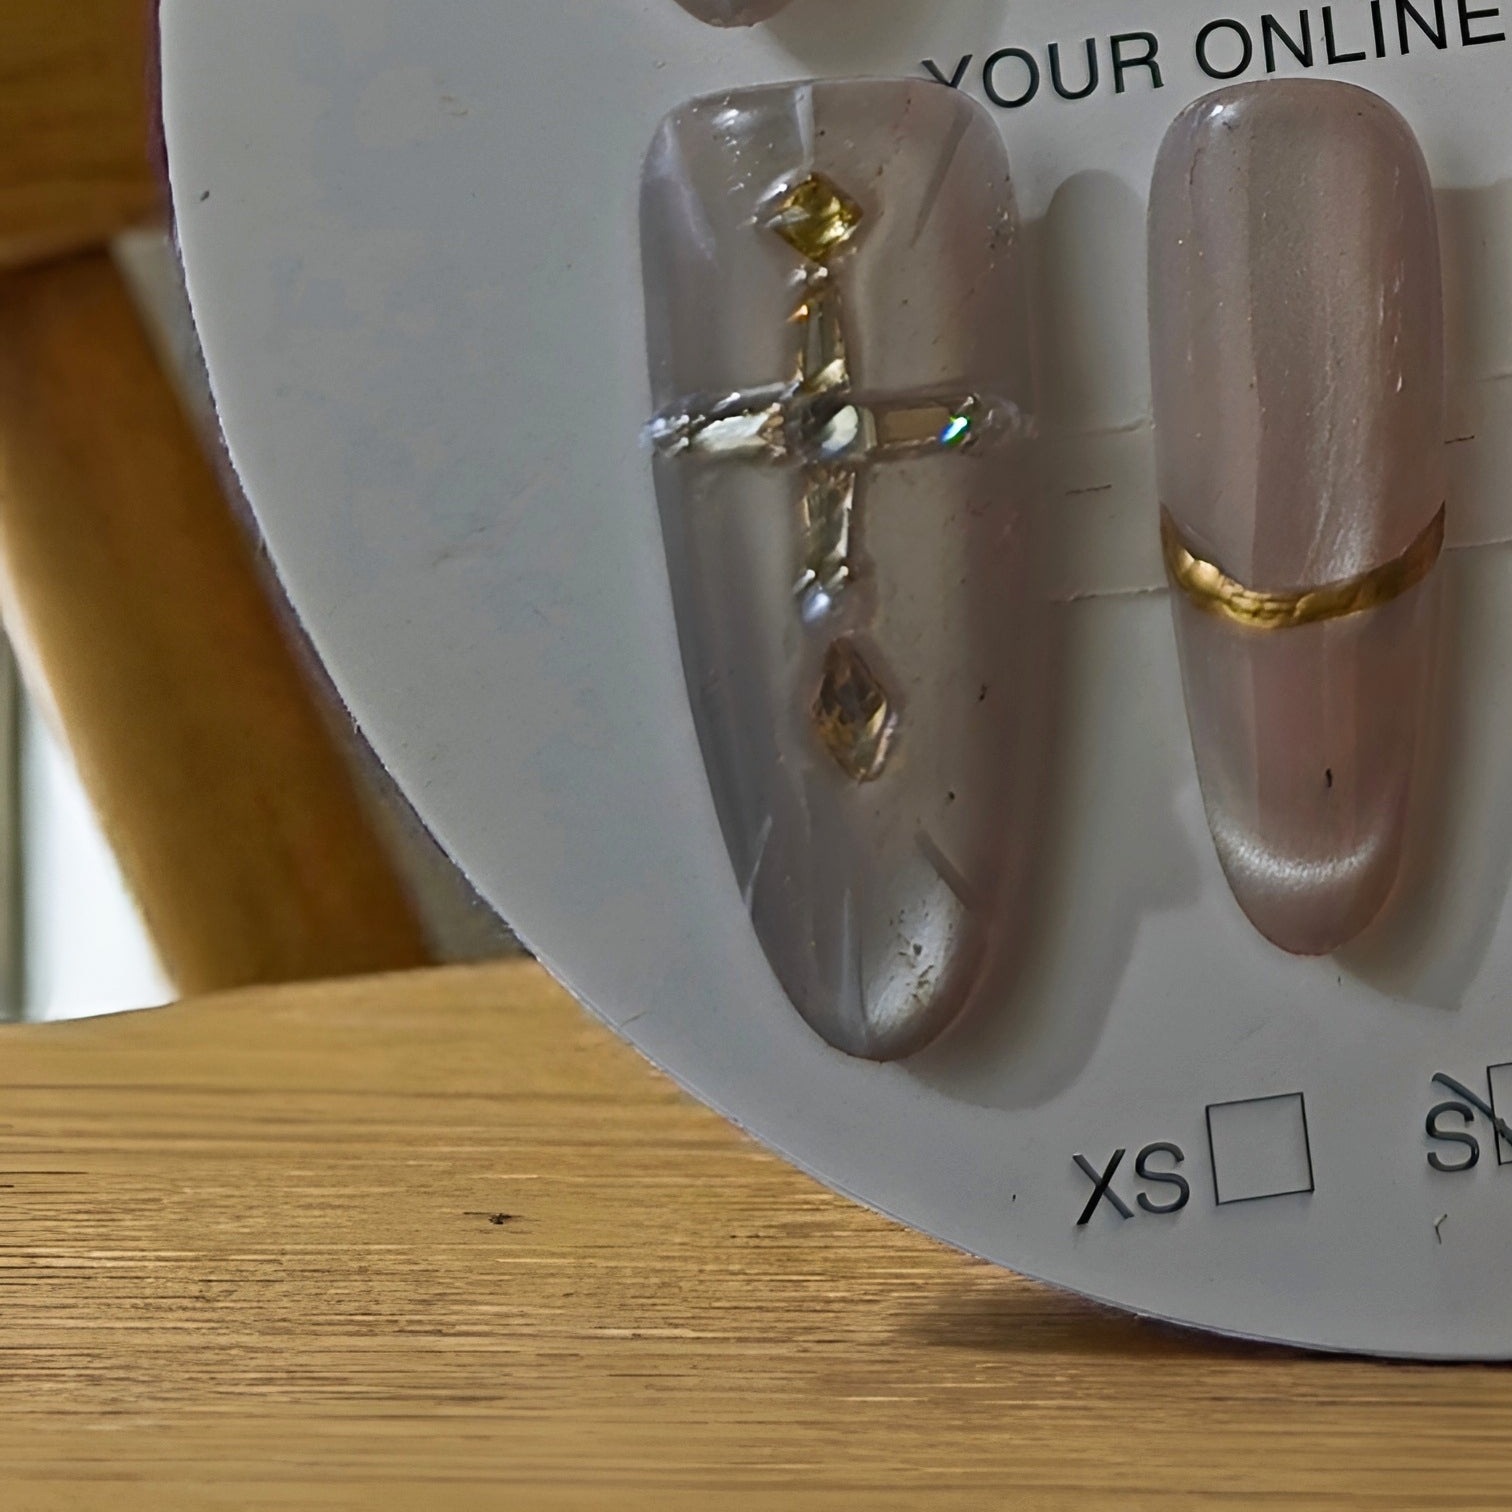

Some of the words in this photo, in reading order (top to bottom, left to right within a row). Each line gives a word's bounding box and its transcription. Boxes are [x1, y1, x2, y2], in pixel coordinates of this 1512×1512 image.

[921, 30, 1165, 109] YOUR
[1072, 1141, 1190, 1226] XS
[1425, 1101, 1480, 1172] S
